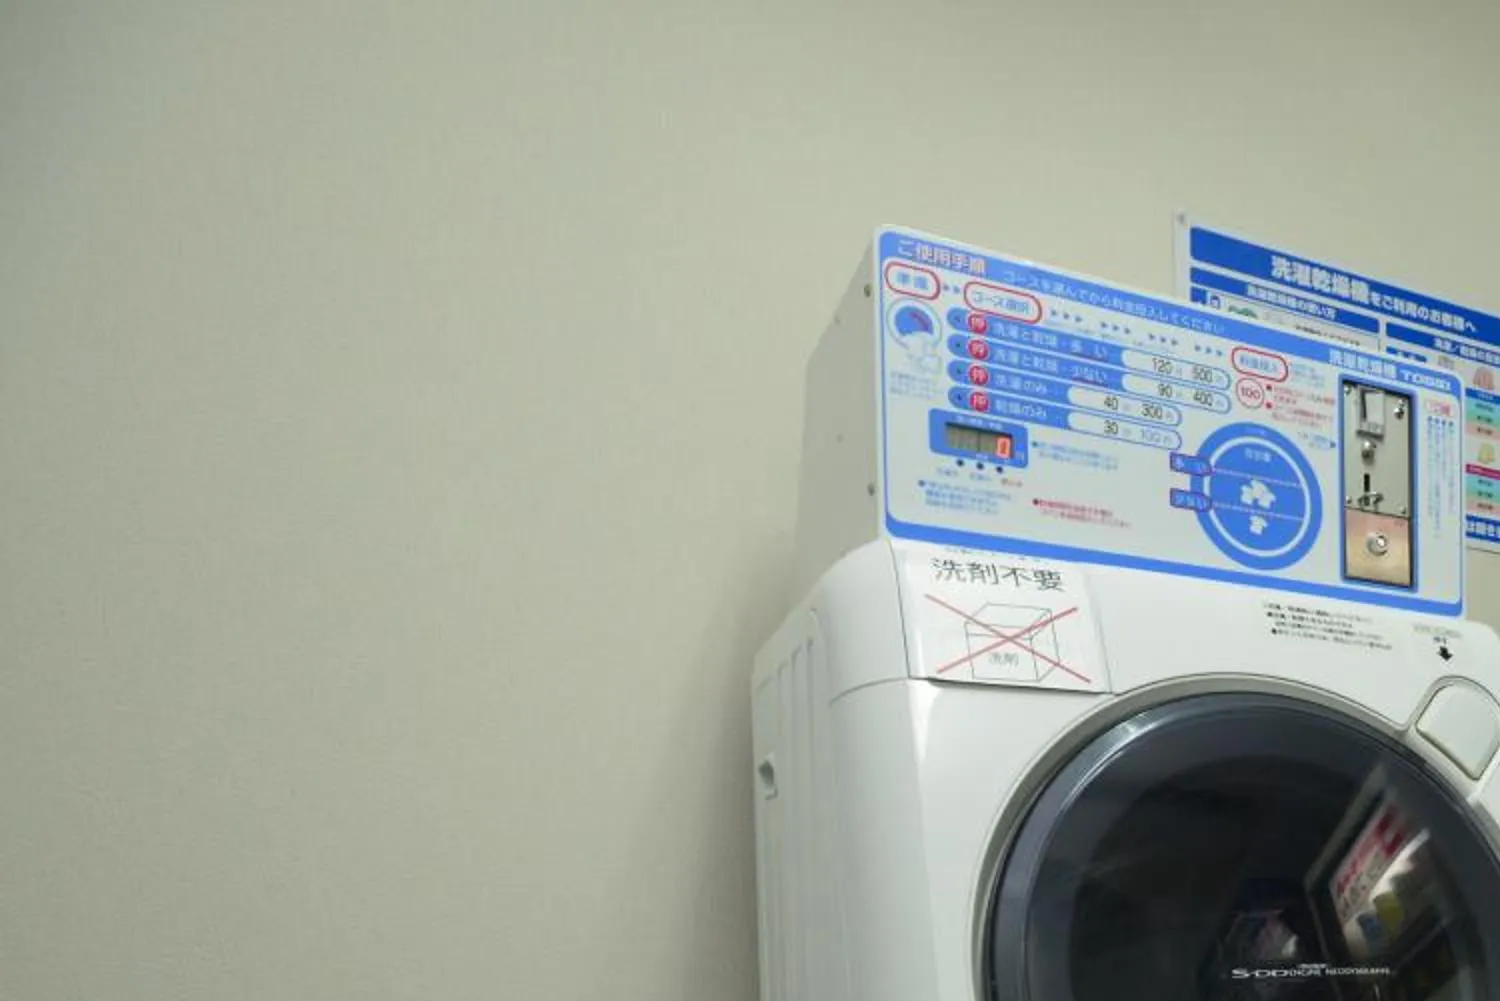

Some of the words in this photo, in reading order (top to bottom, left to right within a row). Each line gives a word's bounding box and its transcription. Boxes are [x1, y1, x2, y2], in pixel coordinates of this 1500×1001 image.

[1270, 254, 1477, 333] 洗濯乾燥機をご利用のお客様へ
[931, 556, 1067, 593] 洗剤不要
